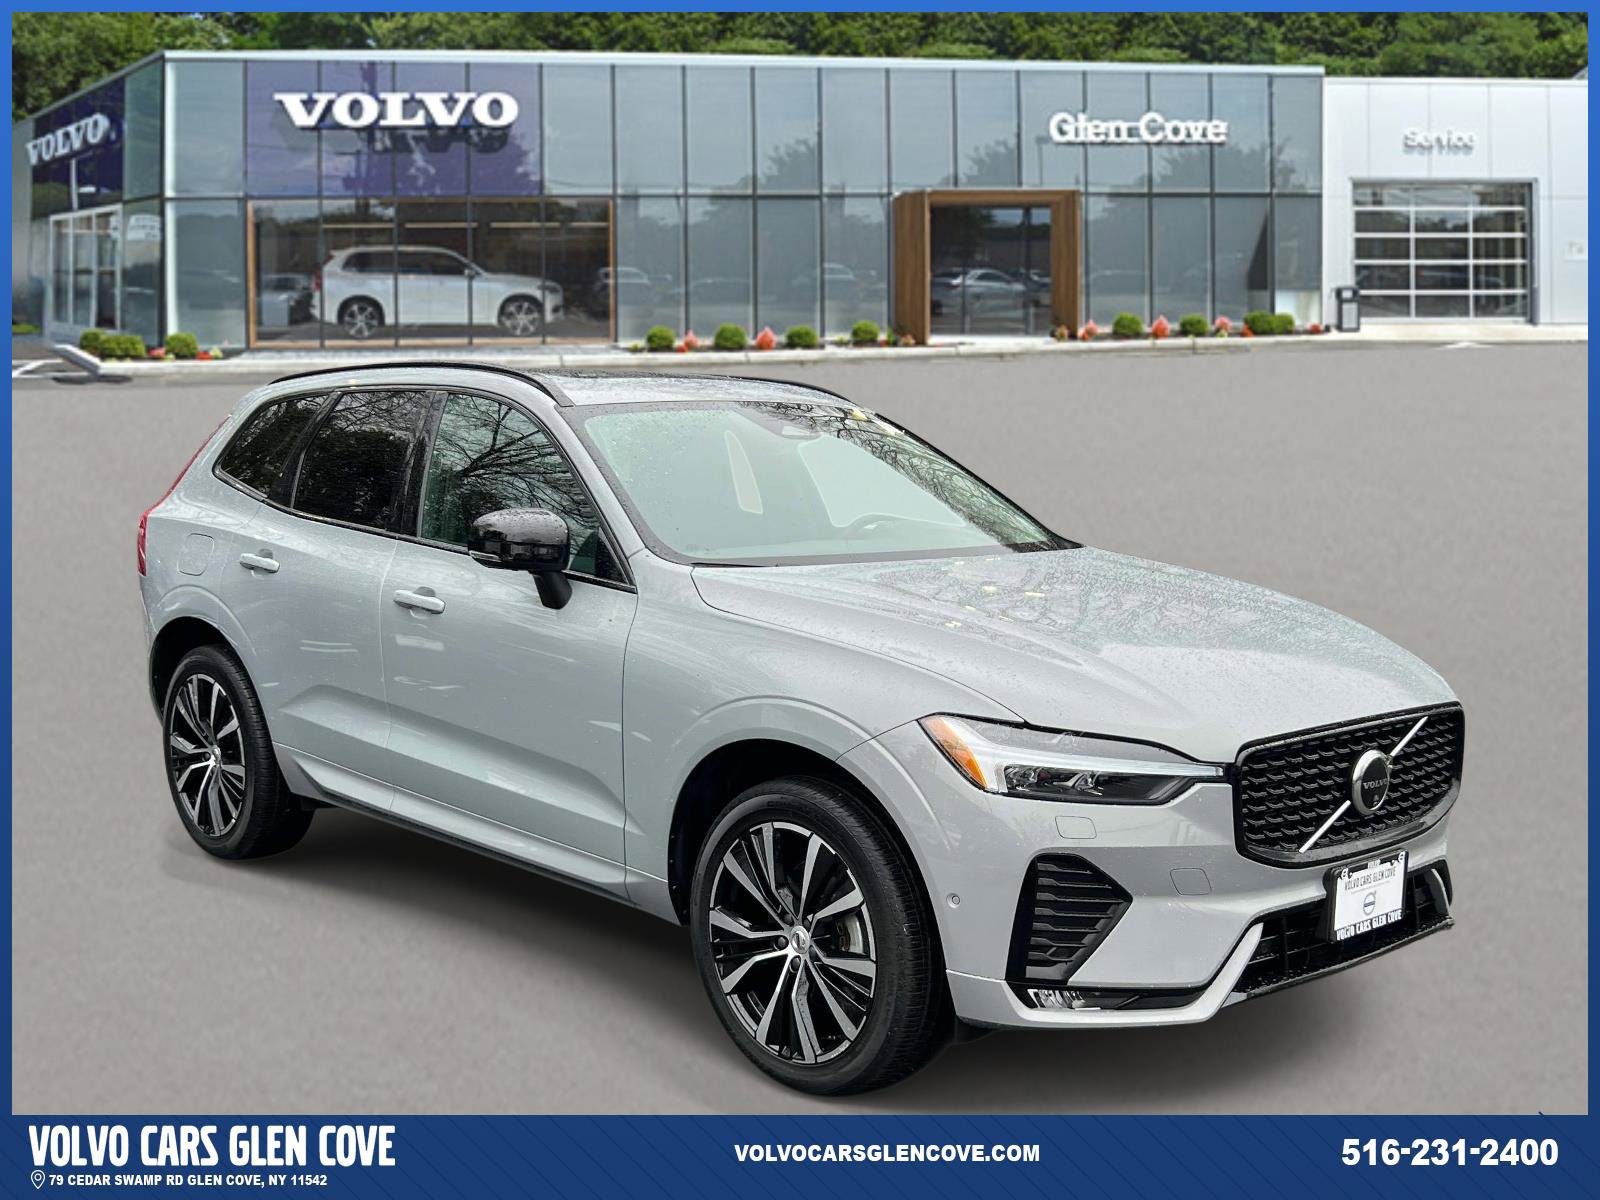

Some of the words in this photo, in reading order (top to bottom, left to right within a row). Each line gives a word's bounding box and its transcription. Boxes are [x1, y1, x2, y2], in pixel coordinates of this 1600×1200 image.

[273, 92, 519, 128] VOLVO
[25, 113, 111, 166] VOLVO
[1049, 111, 1130, 144] Glen
[1138, 111, 1228, 144] Cove
[1402, 127, 1476, 150] Service
[1336, 925, 1355, 940] VOLVO
[1356, 920, 1371, 934] CARS
[1372, 915, 1387, 928] GLEN
[1388, 910, 1402, 922] COVE
